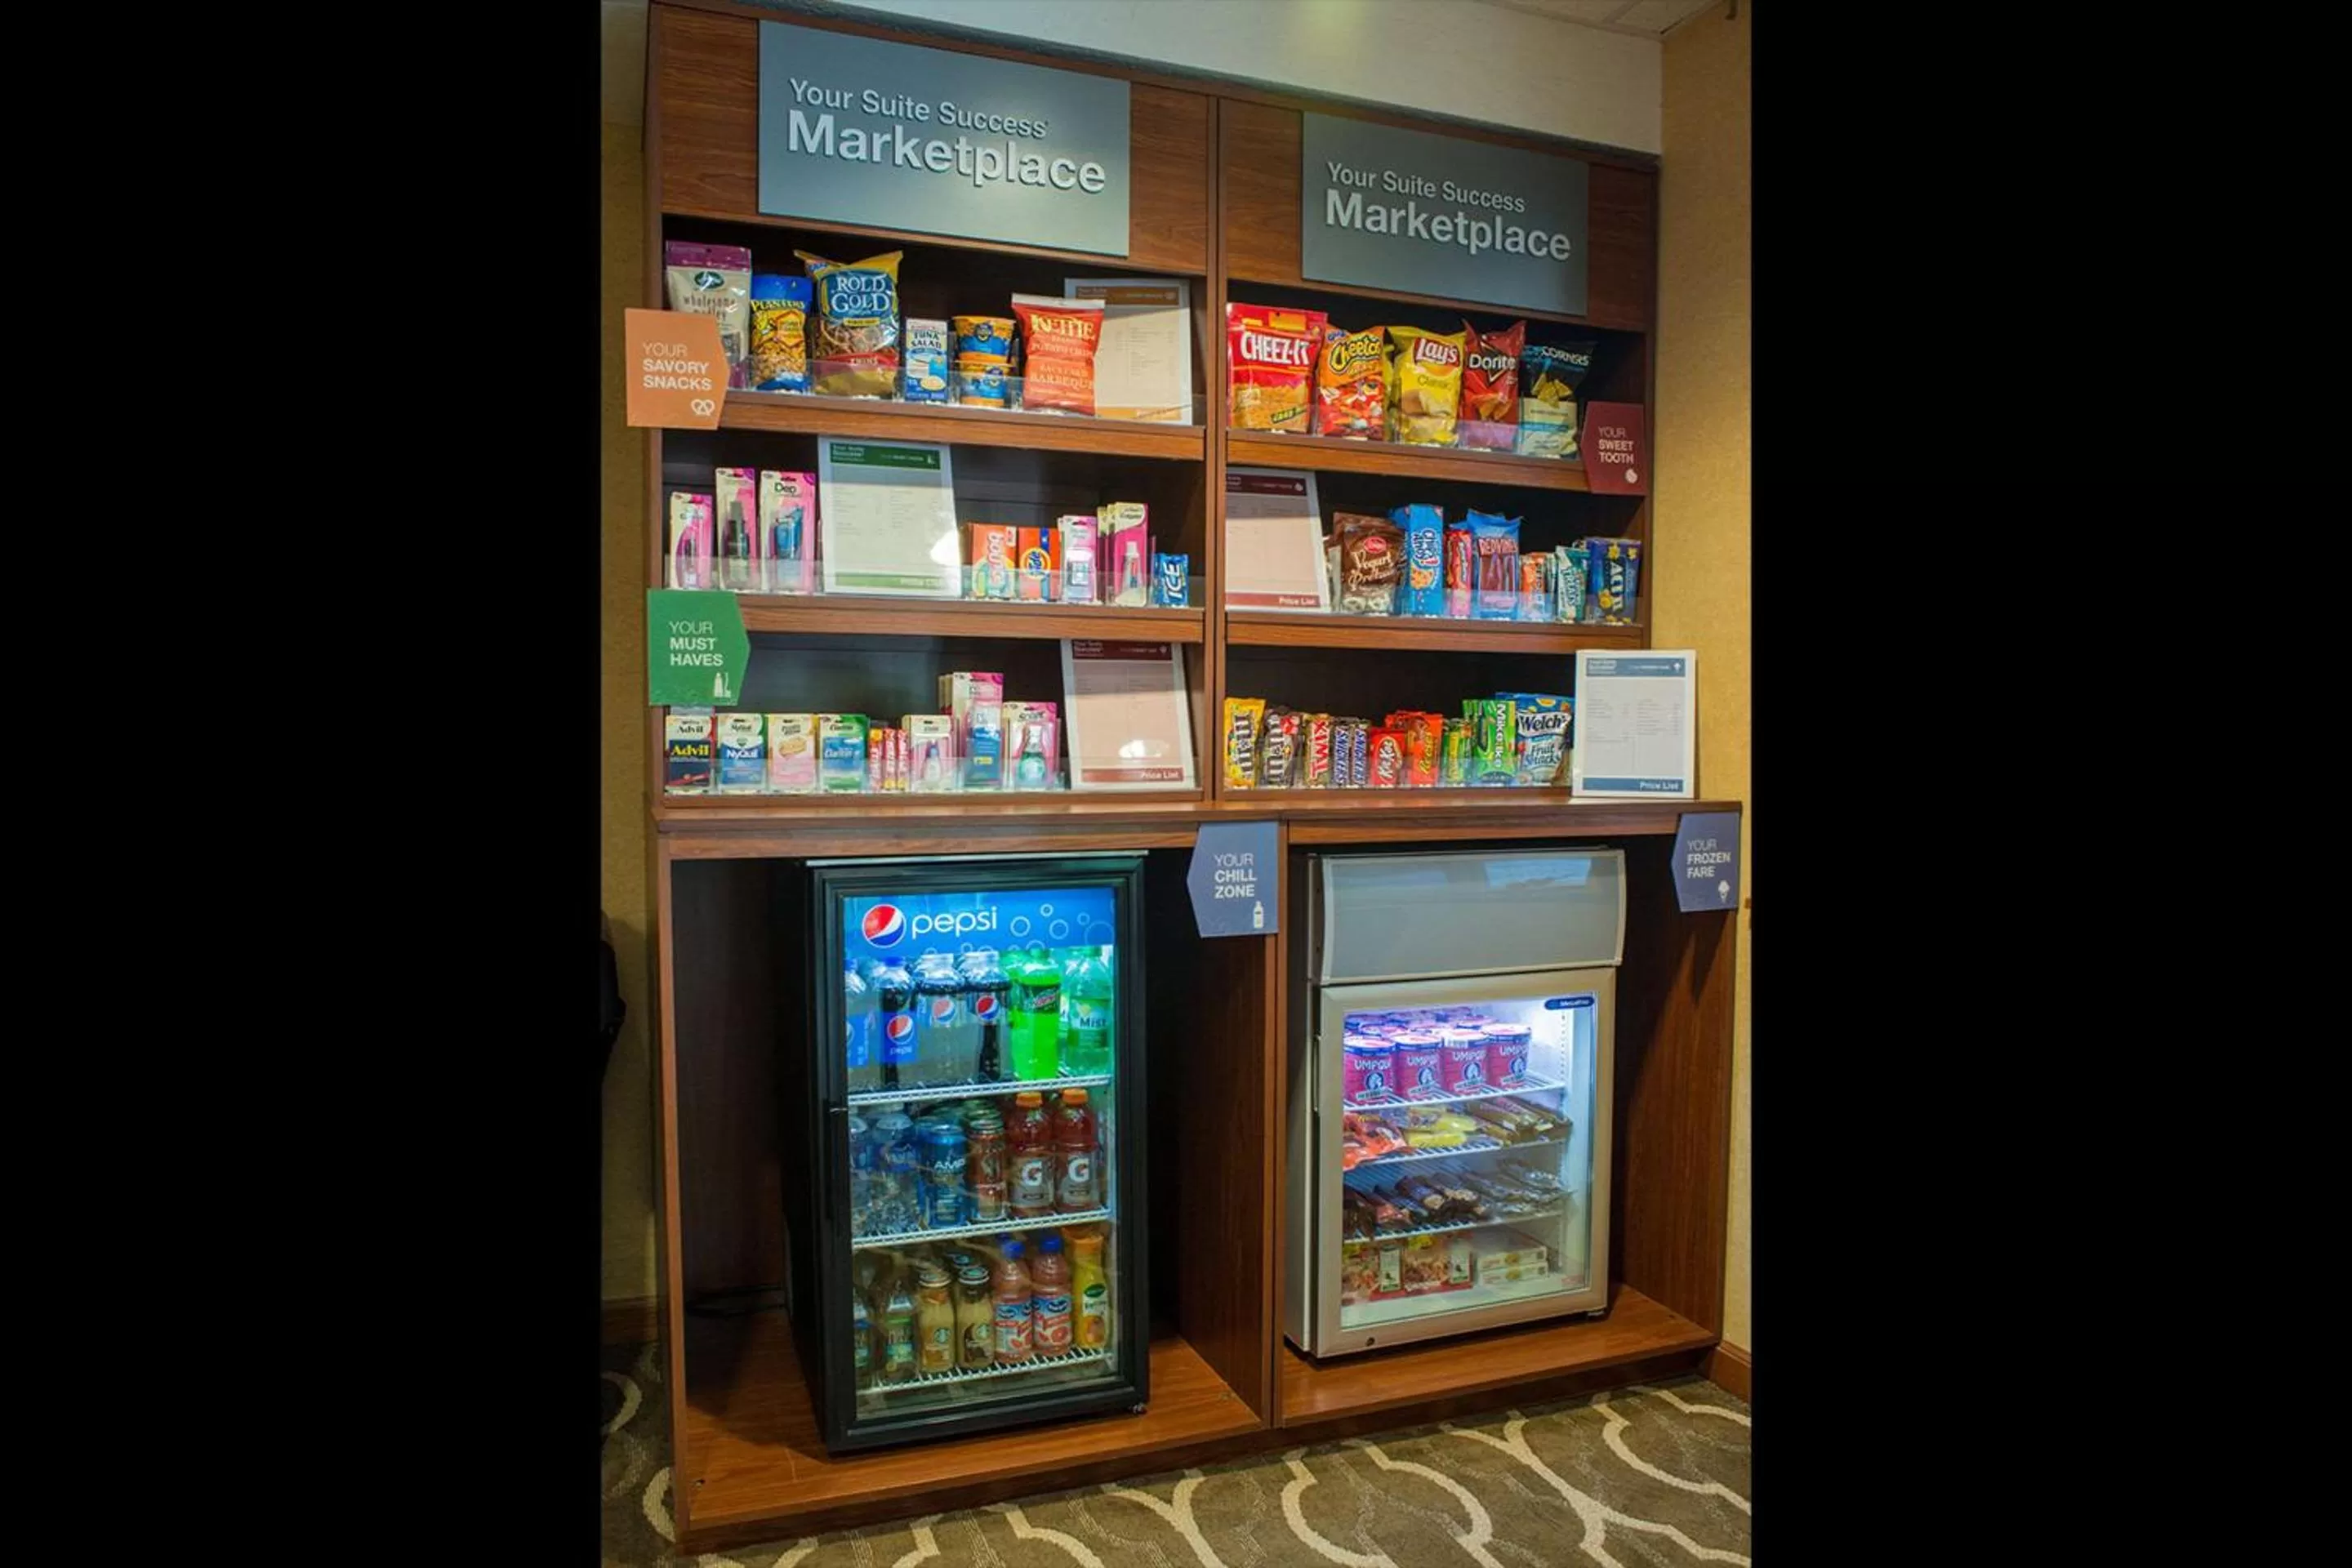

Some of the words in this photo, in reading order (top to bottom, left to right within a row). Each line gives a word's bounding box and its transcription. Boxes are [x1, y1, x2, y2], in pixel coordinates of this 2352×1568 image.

[788, 78, 853, 110] Your
[862, 89, 930, 121] Suite
[938, 101, 1045, 138] Success
[786, 109, 1107, 194] Marketplace
[1327, 161, 1378, 189] Your
[1382, 170, 1437, 198] Suite
[1442, 180, 1526, 213] Success
[1325, 189, 1572, 262] Marketplace
[835, 274, 888, 293] ROLD
[831, 292, 890, 313] GOLD
[913, 332, 940, 341] TUNA
[643, 341, 688, 357] YOUR
[1240, 330, 1311, 366] CHEEZ-IT
[1415, 337, 1459, 364] Lay's
[642, 359, 709, 375] SAVORY
[643, 375, 713, 391] SNACKS
[1597, 426, 1626, 439] YOUR
[1598, 439, 1634, 451] SWEET
[1599, 451, 1634, 464] TOOTH
[1163, 562, 1182, 599] ICE
[669, 621, 714, 635] YOUR
[670, 637, 717, 651] MUST
[670, 653, 724, 666] HAVES
[670, 744, 710, 756] Advil
[1686, 839, 1717, 852] YOUR
[1214, 853, 1254, 868] YOUR
[1686, 851, 1731, 866] FROZEN
[1214, 868, 1257, 884] CHILL
[1686, 866, 1716, 880] FARE
[1215, 883, 1255, 898] ZONE
[911, 906, 998, 940] pepsi
[1067, 1156, 1090, 1183] G
